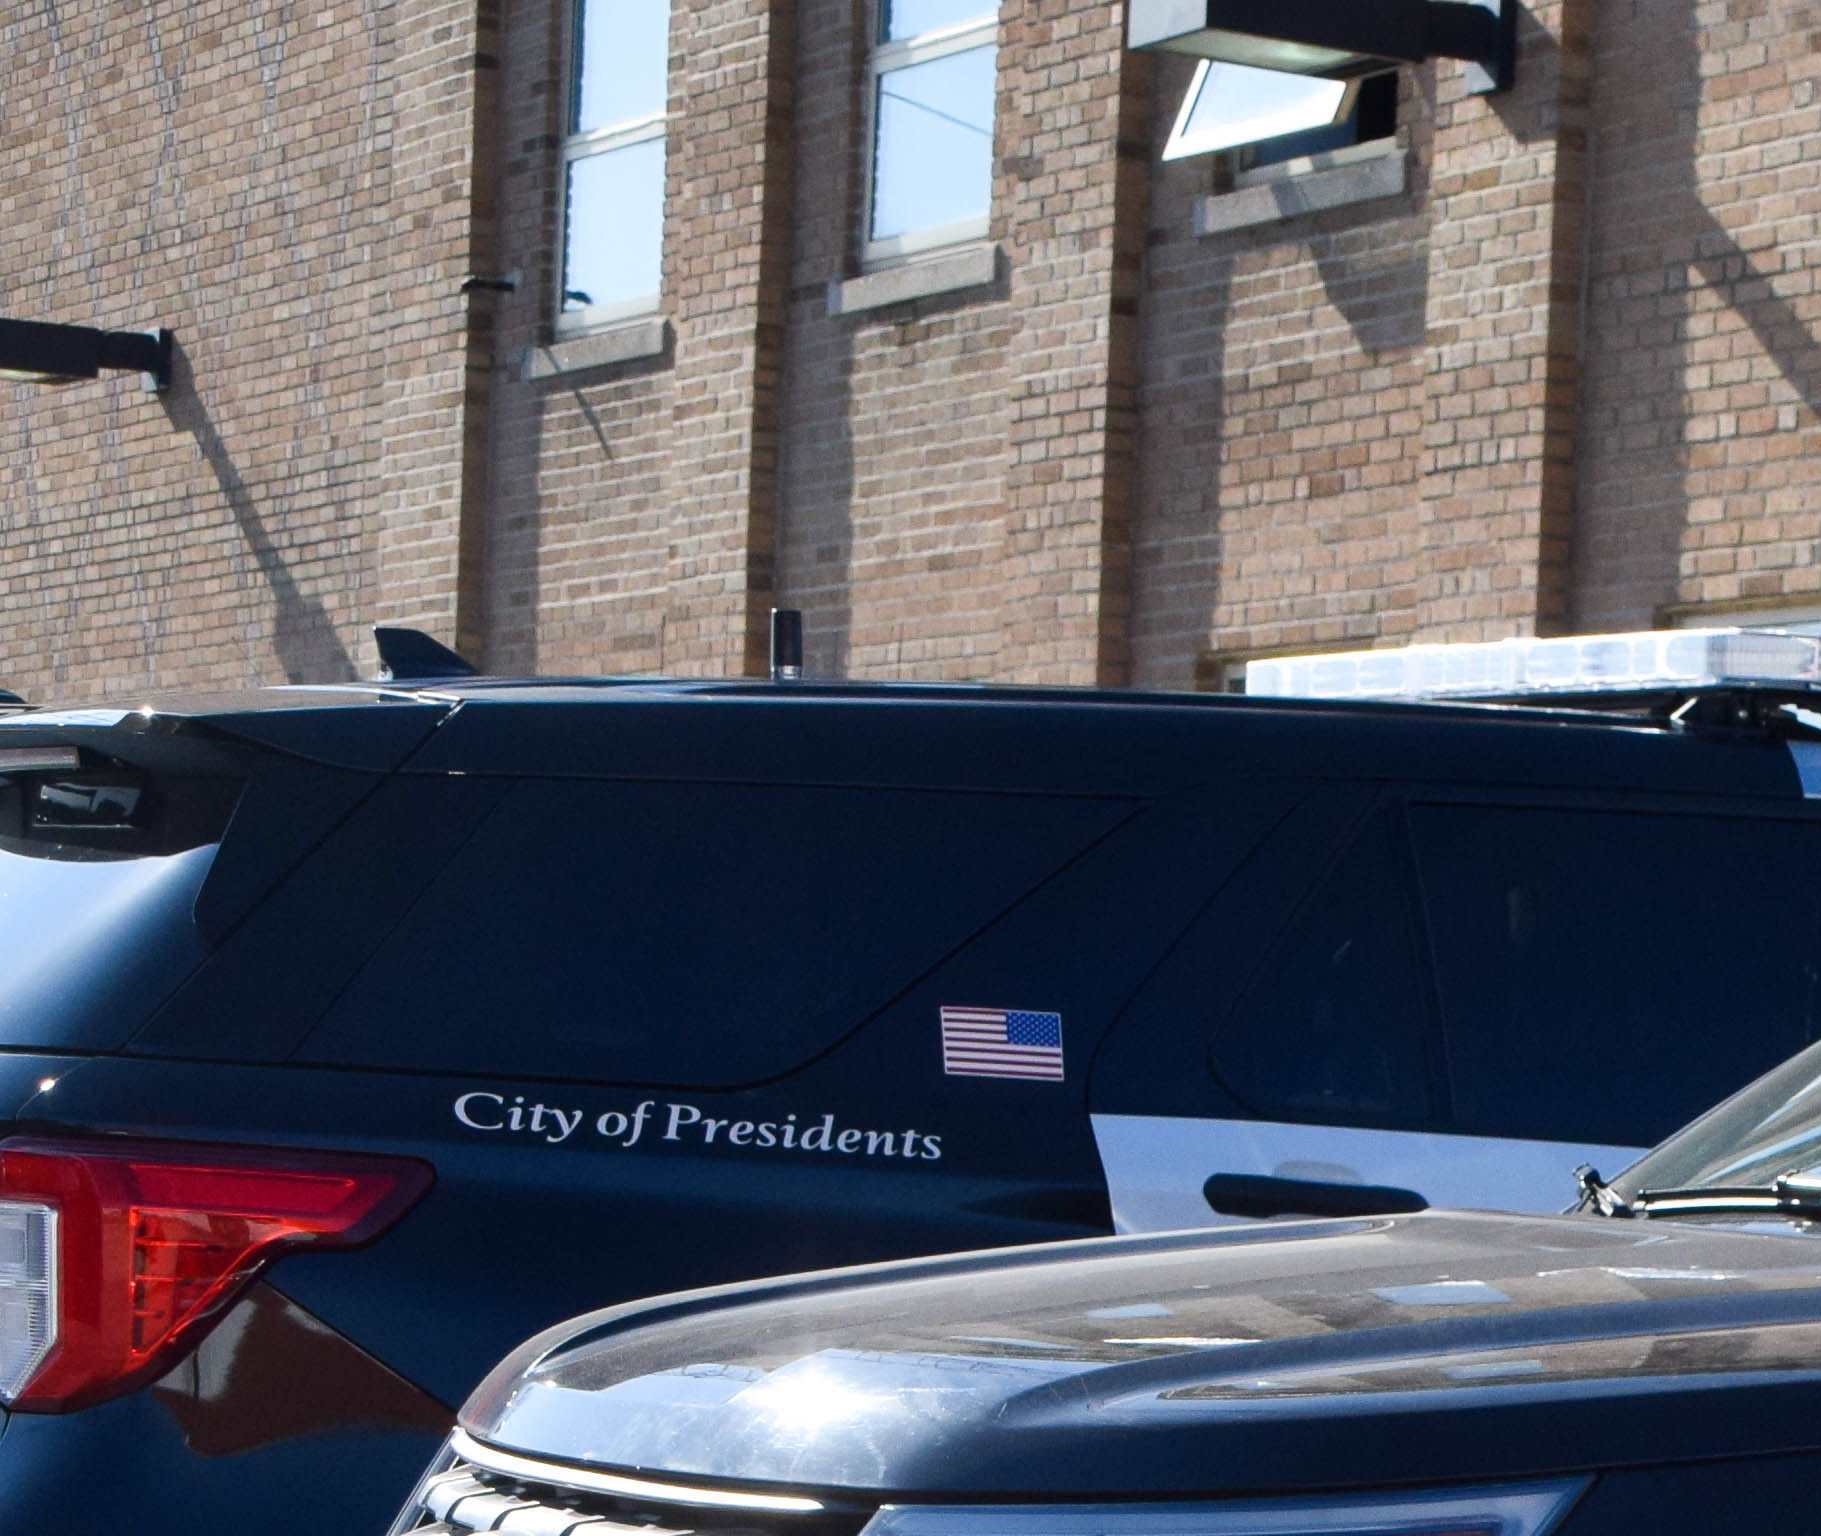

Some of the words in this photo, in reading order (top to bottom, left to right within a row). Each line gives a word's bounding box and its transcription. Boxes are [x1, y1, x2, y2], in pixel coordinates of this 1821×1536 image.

[454, 1092, 583, 1143] City
[596, 1100, 655, 1147] of
[663, 1103, 942, 1160] Presidents
